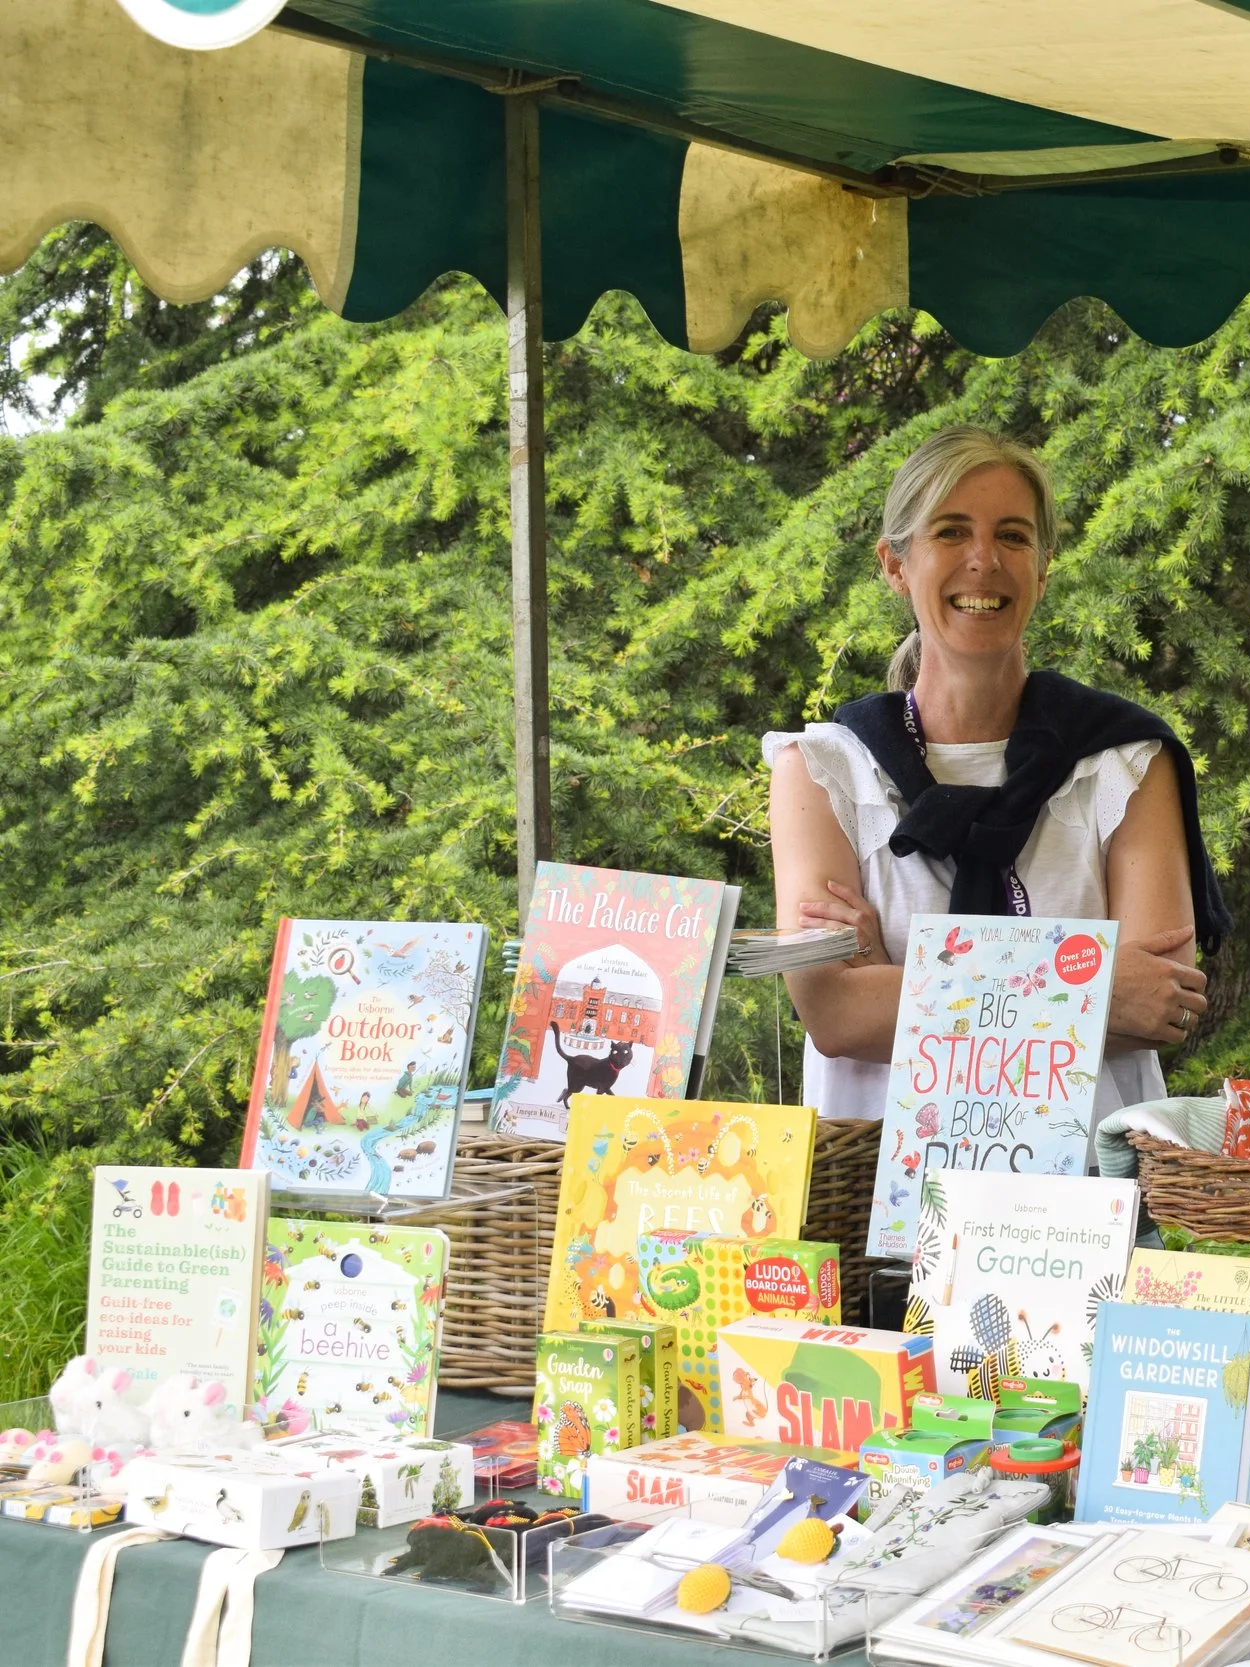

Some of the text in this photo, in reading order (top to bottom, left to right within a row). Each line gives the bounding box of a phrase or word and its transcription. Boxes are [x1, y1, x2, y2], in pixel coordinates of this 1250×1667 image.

[547, 887, 703, 939] The Palace Cat
[980, 925, 1041, 943] YUVAL ZOMMER
[1060, 947, 1096, 963] Over 200
[1062, 958, 1096, 973] stickers!
[992, 978, 1007, 992] THE
[358, 1003, 394, 1014] Usborne
[979, 993, 1018, 1029] BIG
[328, 1015, 421, 1040] Outdoor
[340, 1040, 394, 1062] Book
[914, 1033, 1077, 1101] STICKER
[950, 1100, 1029, 1140] BOOK OF
[628, 1180, 738, 1203] The Secret Life of
[1014, 1203, 1047, 1214] Usborne
[104, 1224, 136, 1238] The
[880, 1233, 905, 1241] Thames
[963, 1221, 1111, 1250] First Magic Painting
[102, 1241, 246, 1262] Sustainable(ish)
[102, 1257, 230, 1276] Guide to Green
[977, 1245, 1083, 1280] Garden
[755, 1264, 791, 1281] LUDO
[101, 1274, 190, 1294] Parenting
[333, 1287, 367, 1297] usborne
[745, 1279, 807, 1294] BOARD GAME
[820, 1273, 828, 1302] LUDO
[101, 1296, 172, 1311] Guilt-free
[320, 1299, 378, 1315] peep inside
[757, 1292, 796, 1306] ANIMALS
[1196, 1294, 1210, 1302] The
[1214, 1295, 1247, 1306] LITTLE
[172, 1315, 193, 1327] for
[324, 1323, 337, 1336] a
[98, 1329, 152, 1343] raising
[800, 1328, 868, 1345] SLAM
[1166, 1328, 1181, 1337] THE
[98, 1343, 167, 1356] your kids
[300, 1328, 390, 1361] beehive
[1111, 1333, 1233, 1364] WINDOWSILL
[547, 1353, 604, 1380] Garden
[1120, 1360, 1218, 1389] GARDENER
[559, 1377, 593, 1404] Snap
[663, 1361, 673, 1405] Garden
[626, 1375, 635, 1418] Garden
[777, 1381, 874, 1452] SLAM
[895, 1465, 918, 1475] Double
[626, 1469, 685, 1507] SLAM
[884, 1473, 931, 1488] Magnifying
[1104, 1505, 1113, 1513] 50
[1115, 1507, 1166, 1519] Easy-to-grow
[1168, 1513, 1191, 1523] Plants
